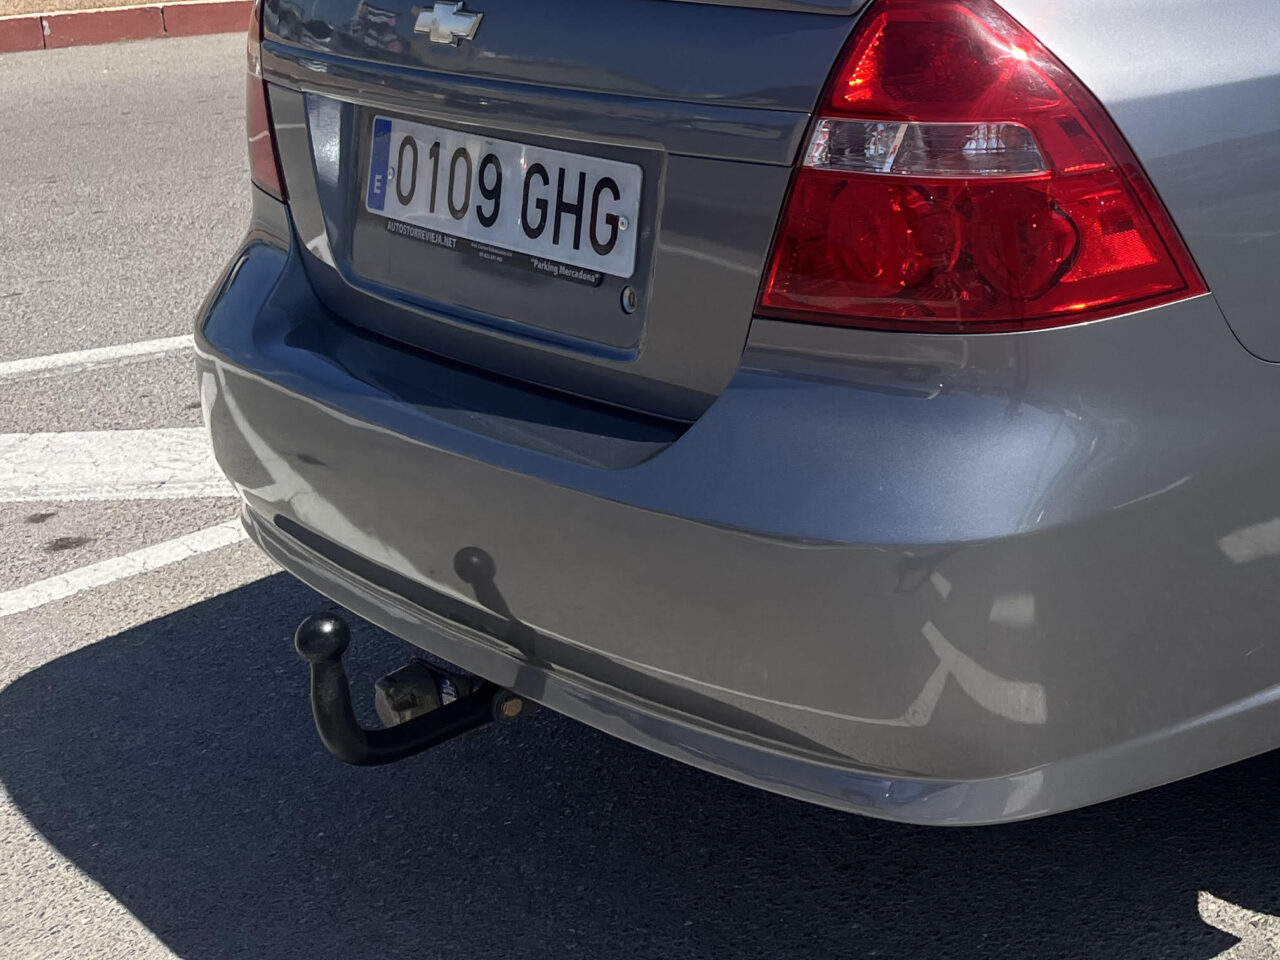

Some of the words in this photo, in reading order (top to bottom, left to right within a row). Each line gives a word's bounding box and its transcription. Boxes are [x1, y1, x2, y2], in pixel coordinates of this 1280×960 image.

[373, 174, 383, 195] E
[395, 135, 503, 228] 0109
[520, 162, 621, 257] GHG
[387, 220, 458, 249] AUTOSTORREVIEJA.NET
